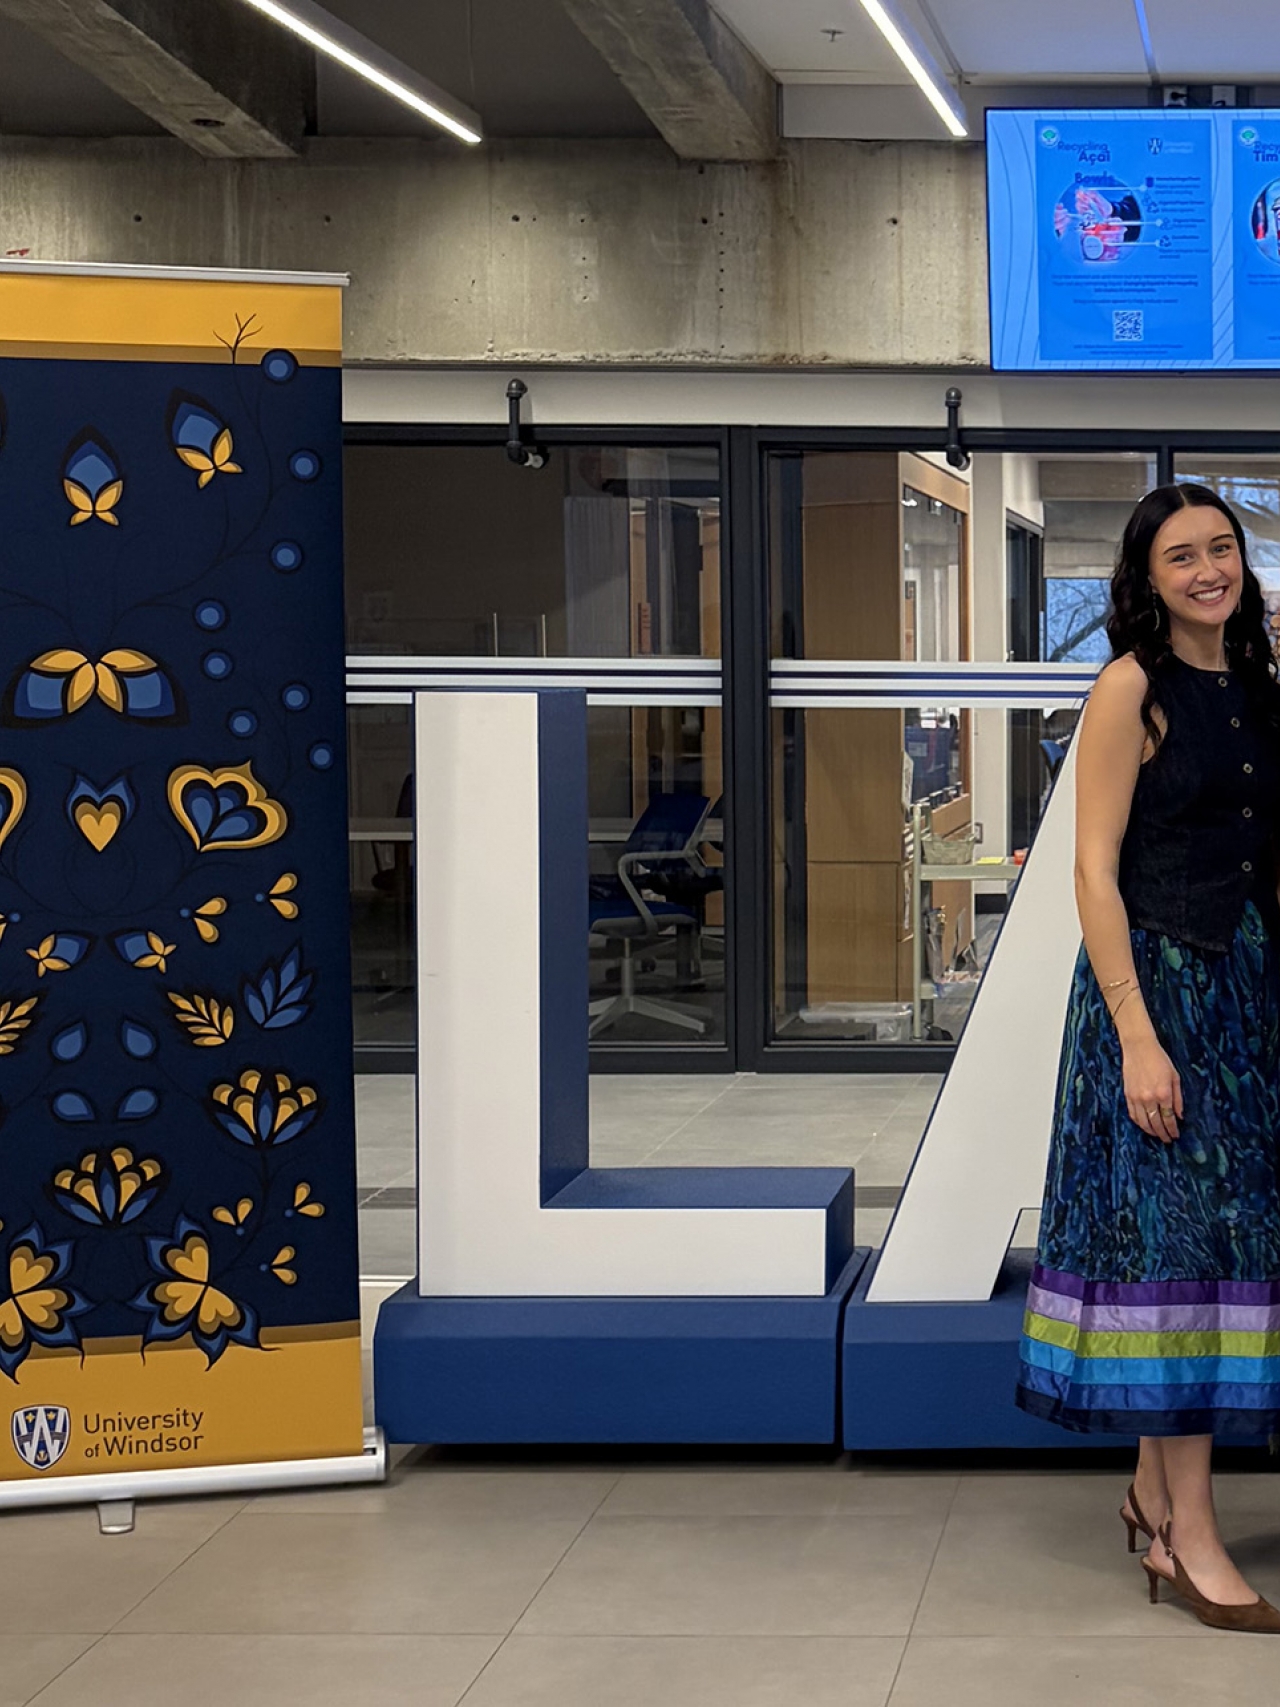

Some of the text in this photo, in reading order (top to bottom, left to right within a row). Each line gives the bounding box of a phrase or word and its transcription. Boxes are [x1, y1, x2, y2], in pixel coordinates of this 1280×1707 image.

[84, 1408, 204, 1434] University
[85, 1432, 204, 1458] of Windsor
